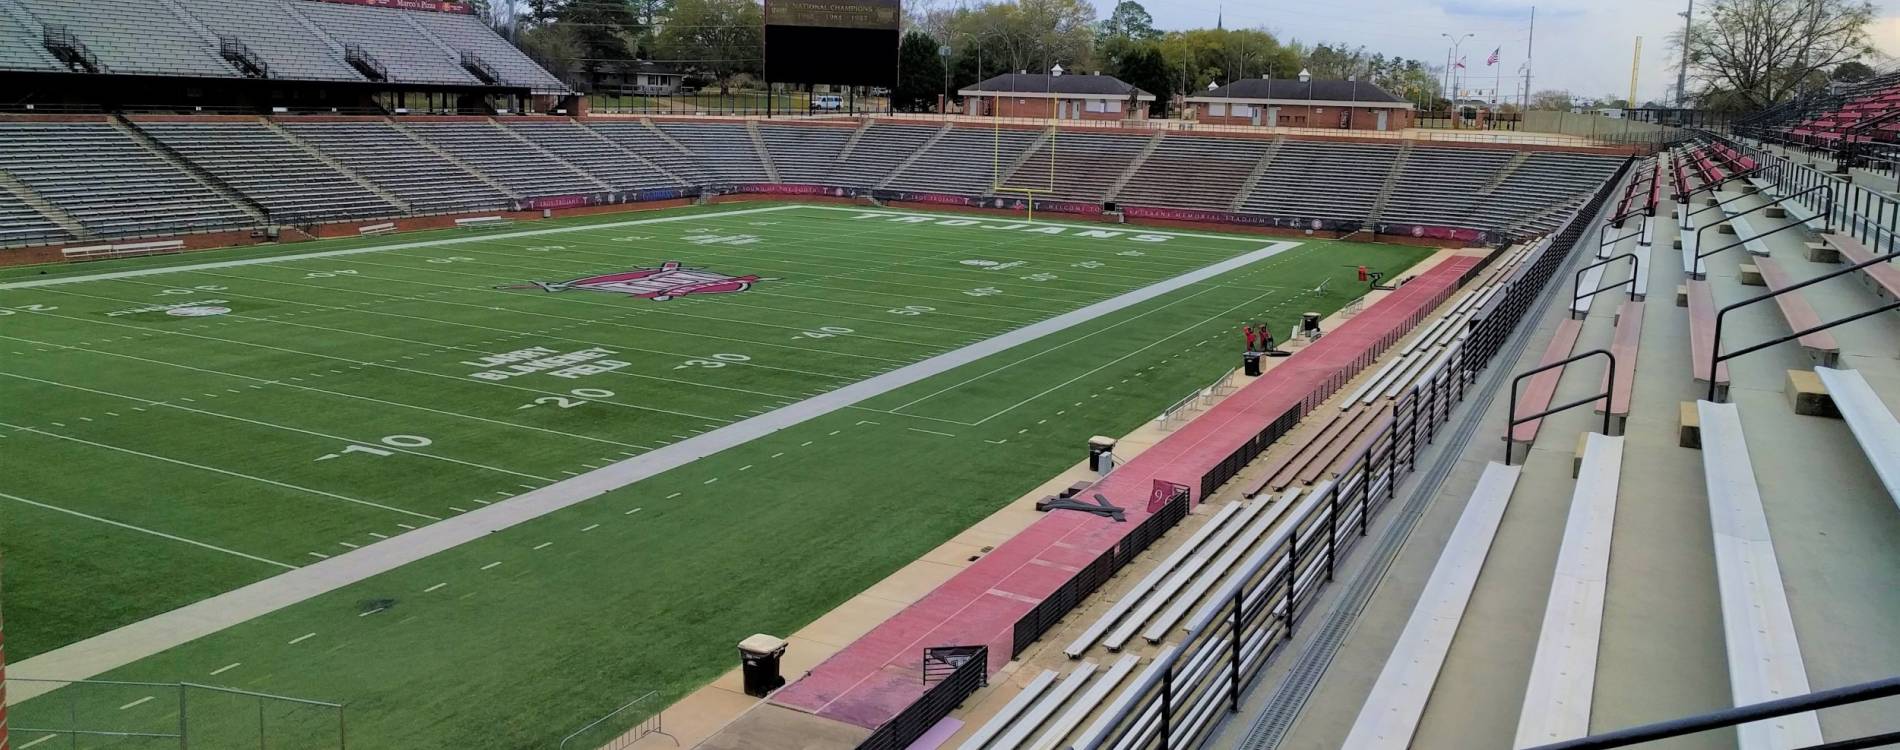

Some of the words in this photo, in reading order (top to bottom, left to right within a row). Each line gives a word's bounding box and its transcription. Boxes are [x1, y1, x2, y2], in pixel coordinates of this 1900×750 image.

[421, 1, 436, 9] Pizza
[831, 4, 873, 12] CHAMPIONS
[1048, 204, 1086, 212] WELCOME
[1175, 211, 1220, 220] MEMORIAL
[1225, 215, 1265, 223] STADIUM
[851, 213, 1175, 242] TROJANS
[801, 326, 855, 339] 40
[459, 346, 560, 368] LARRY
[467, 347, 620, 381] BLAKENEY
[684, 353, 751, 368] 30
[546, 359, 632, 379] FIELD
[534, 388, 615, 408] 20
[340, 434, 432, 457] 10
